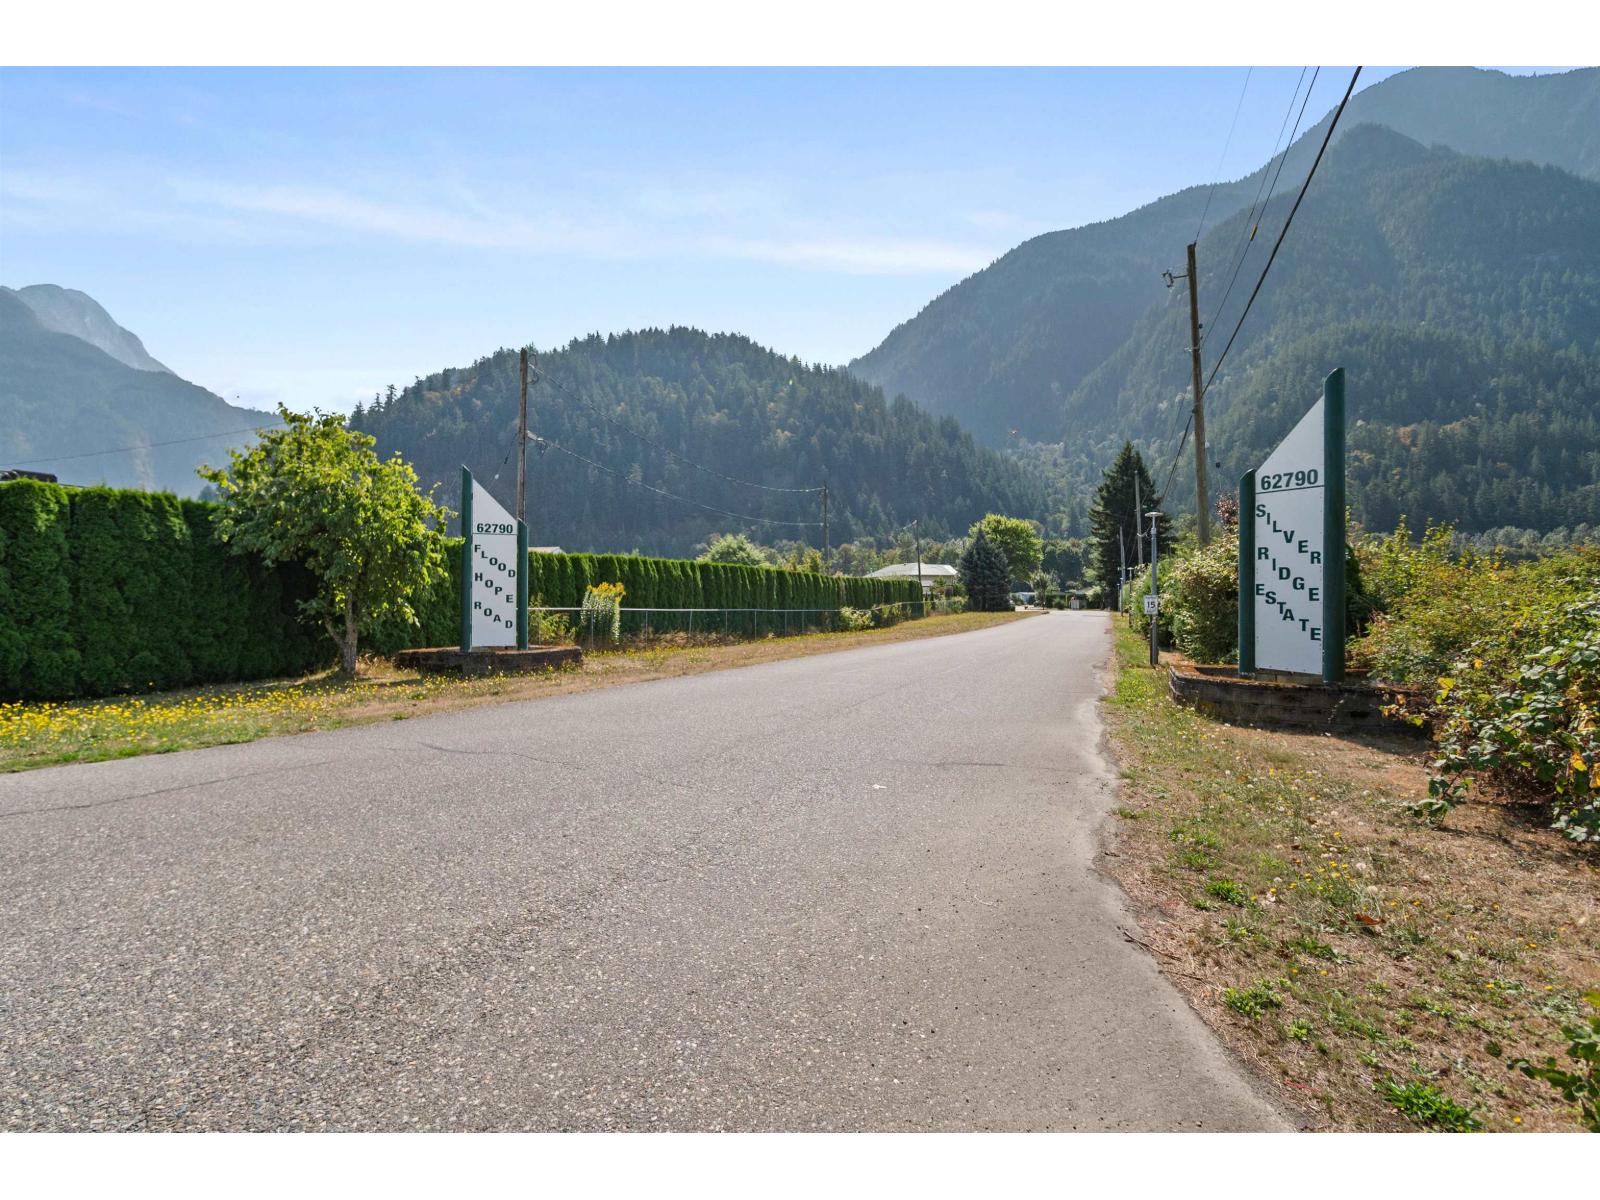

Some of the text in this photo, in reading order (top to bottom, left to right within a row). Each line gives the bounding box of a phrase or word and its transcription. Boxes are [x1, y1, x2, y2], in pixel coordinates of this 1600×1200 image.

[1261, 469, 1318, 490] 62790
[477, 523, 513, 534] 62790
[1256, 504, 1321, 564] SILVER
[474, 544, 516, 578] FLOOD
[1257, 547, 1320, 601] RIDGE
[474, 573, 514, 603] HOPE
[474, 602, 513, 629] ROAD
[1256, 584, 1321, 641] ESTATE
